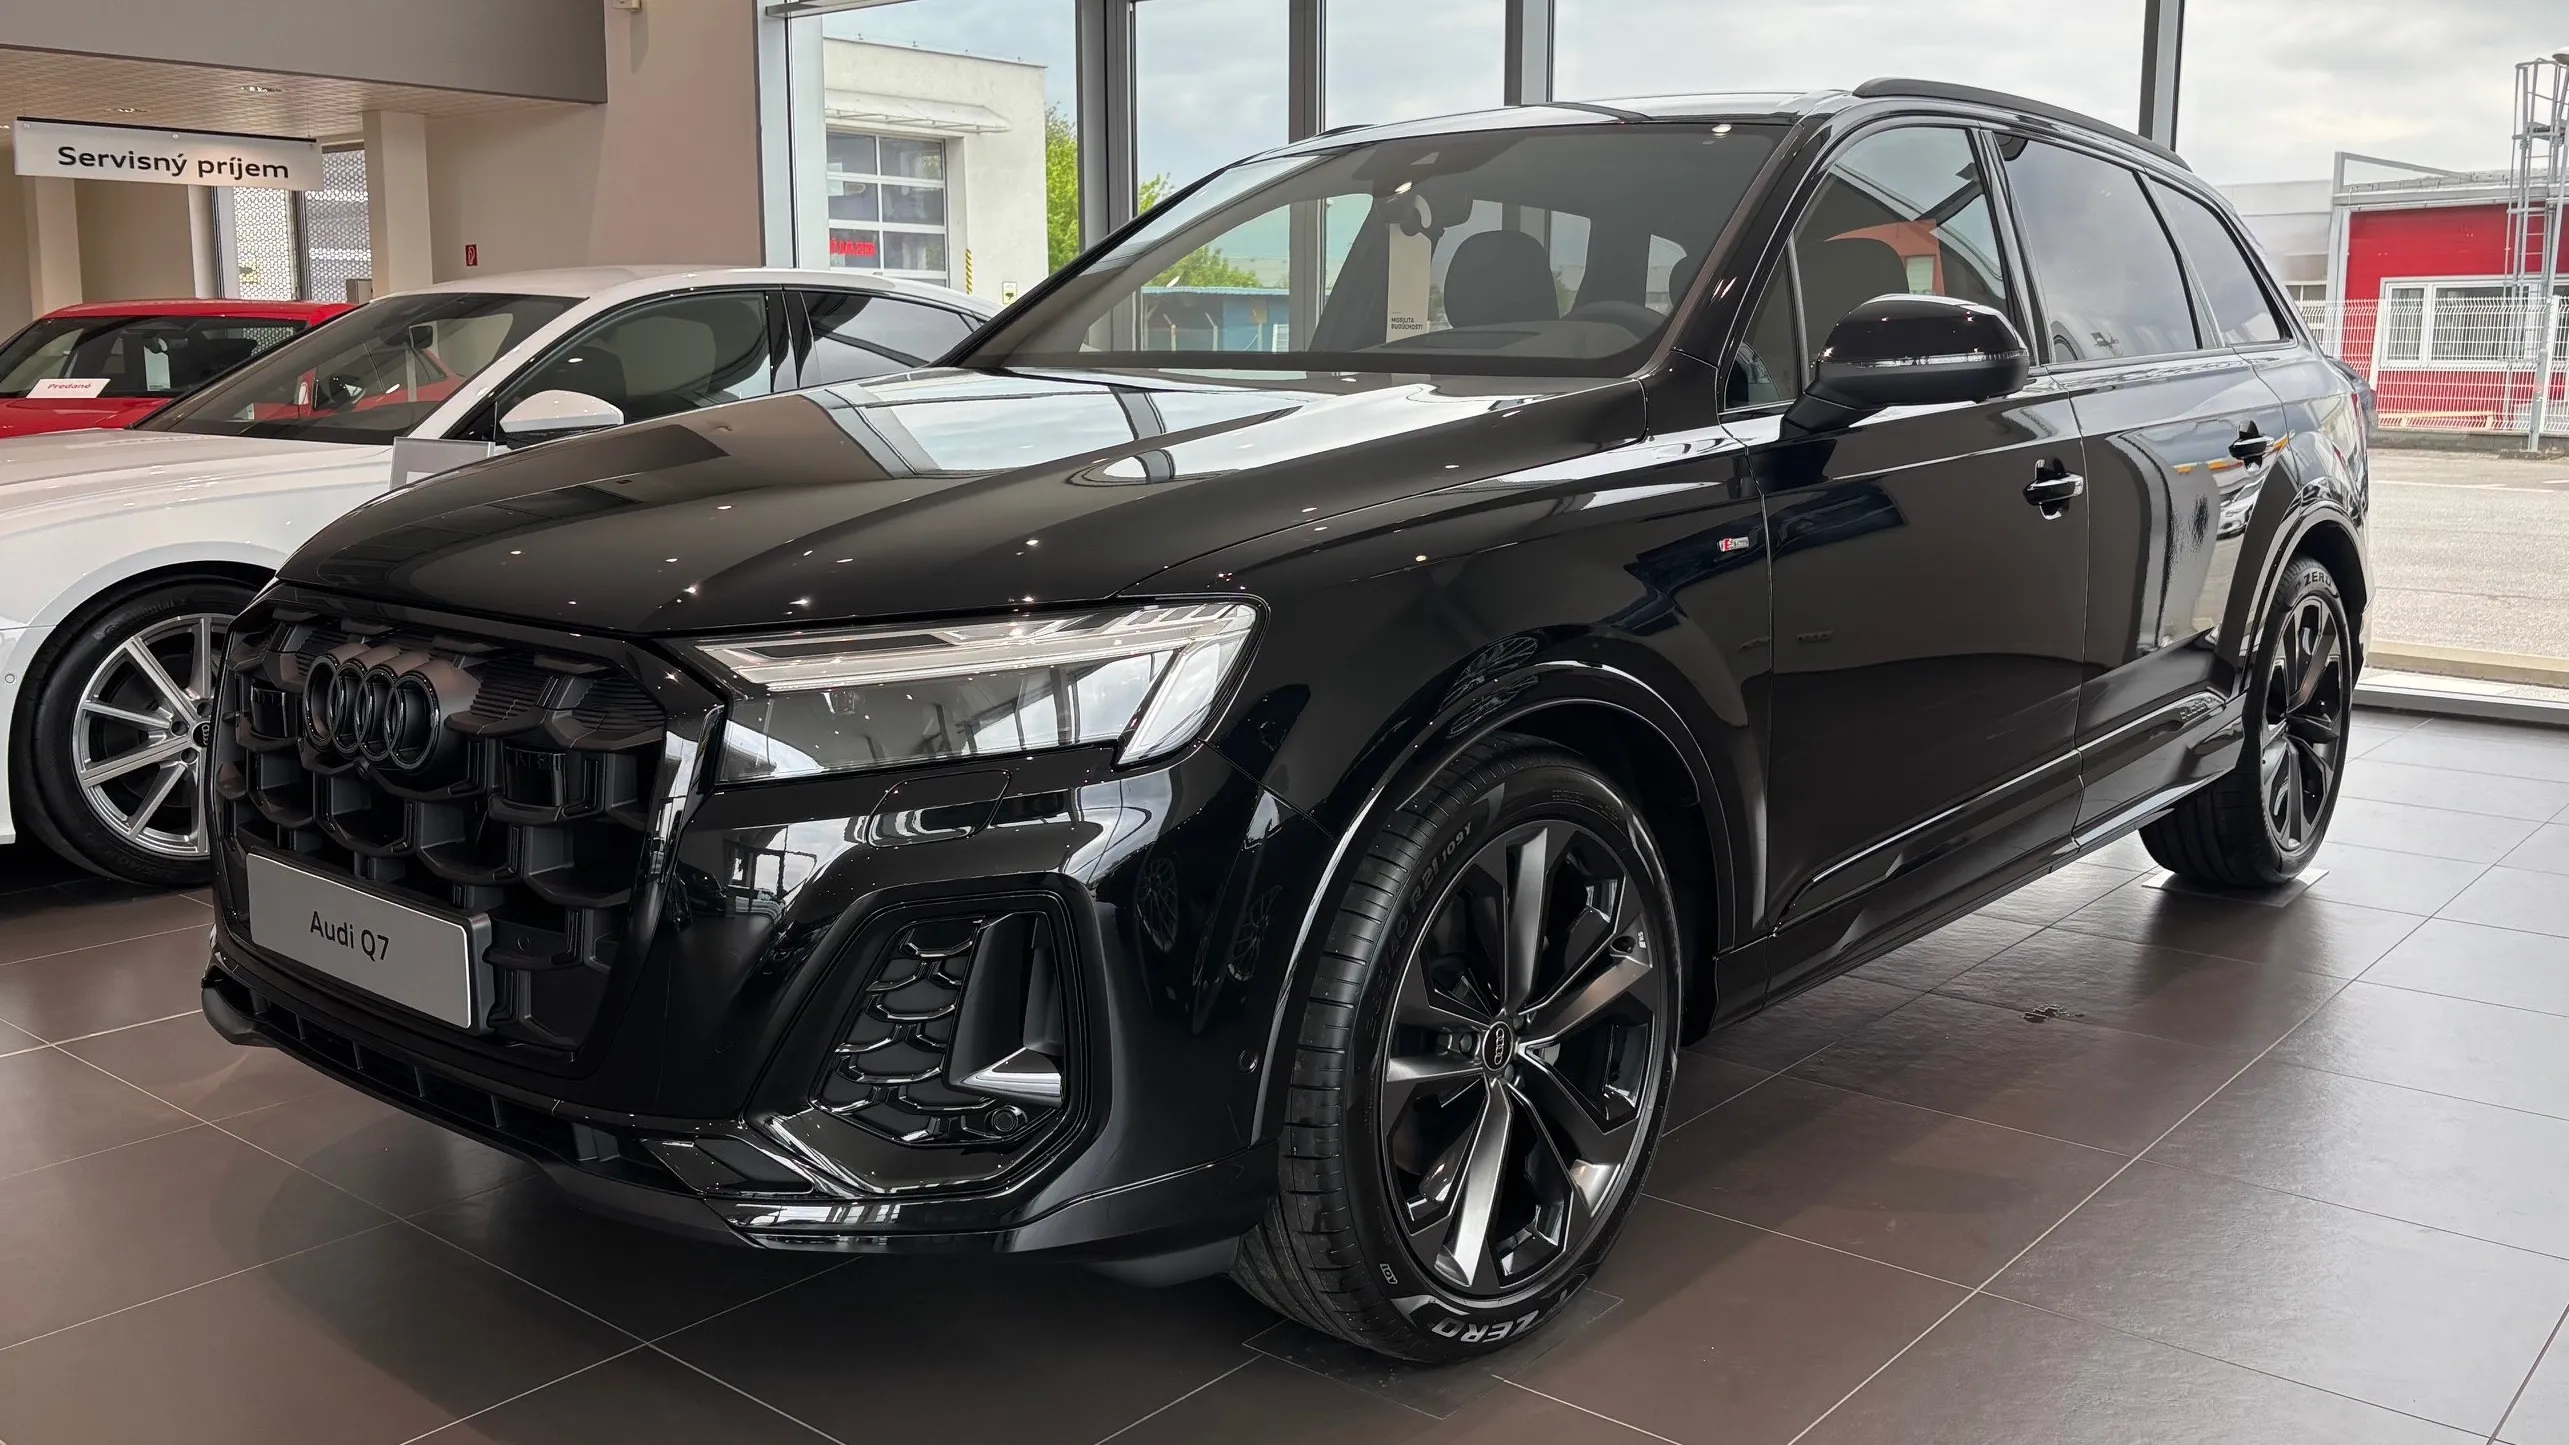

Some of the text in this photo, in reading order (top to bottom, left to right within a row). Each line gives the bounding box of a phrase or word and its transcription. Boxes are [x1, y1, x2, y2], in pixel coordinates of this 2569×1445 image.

[57, 146, 289, 181] Servisný príjem
[2303, 570, 2331, 588] ZERO
[1440, 821, 1473, 863] 109Y
[309, 910, 390, 962] Audi Q7
[1431, 1309, 1539, 1344] ZERO
